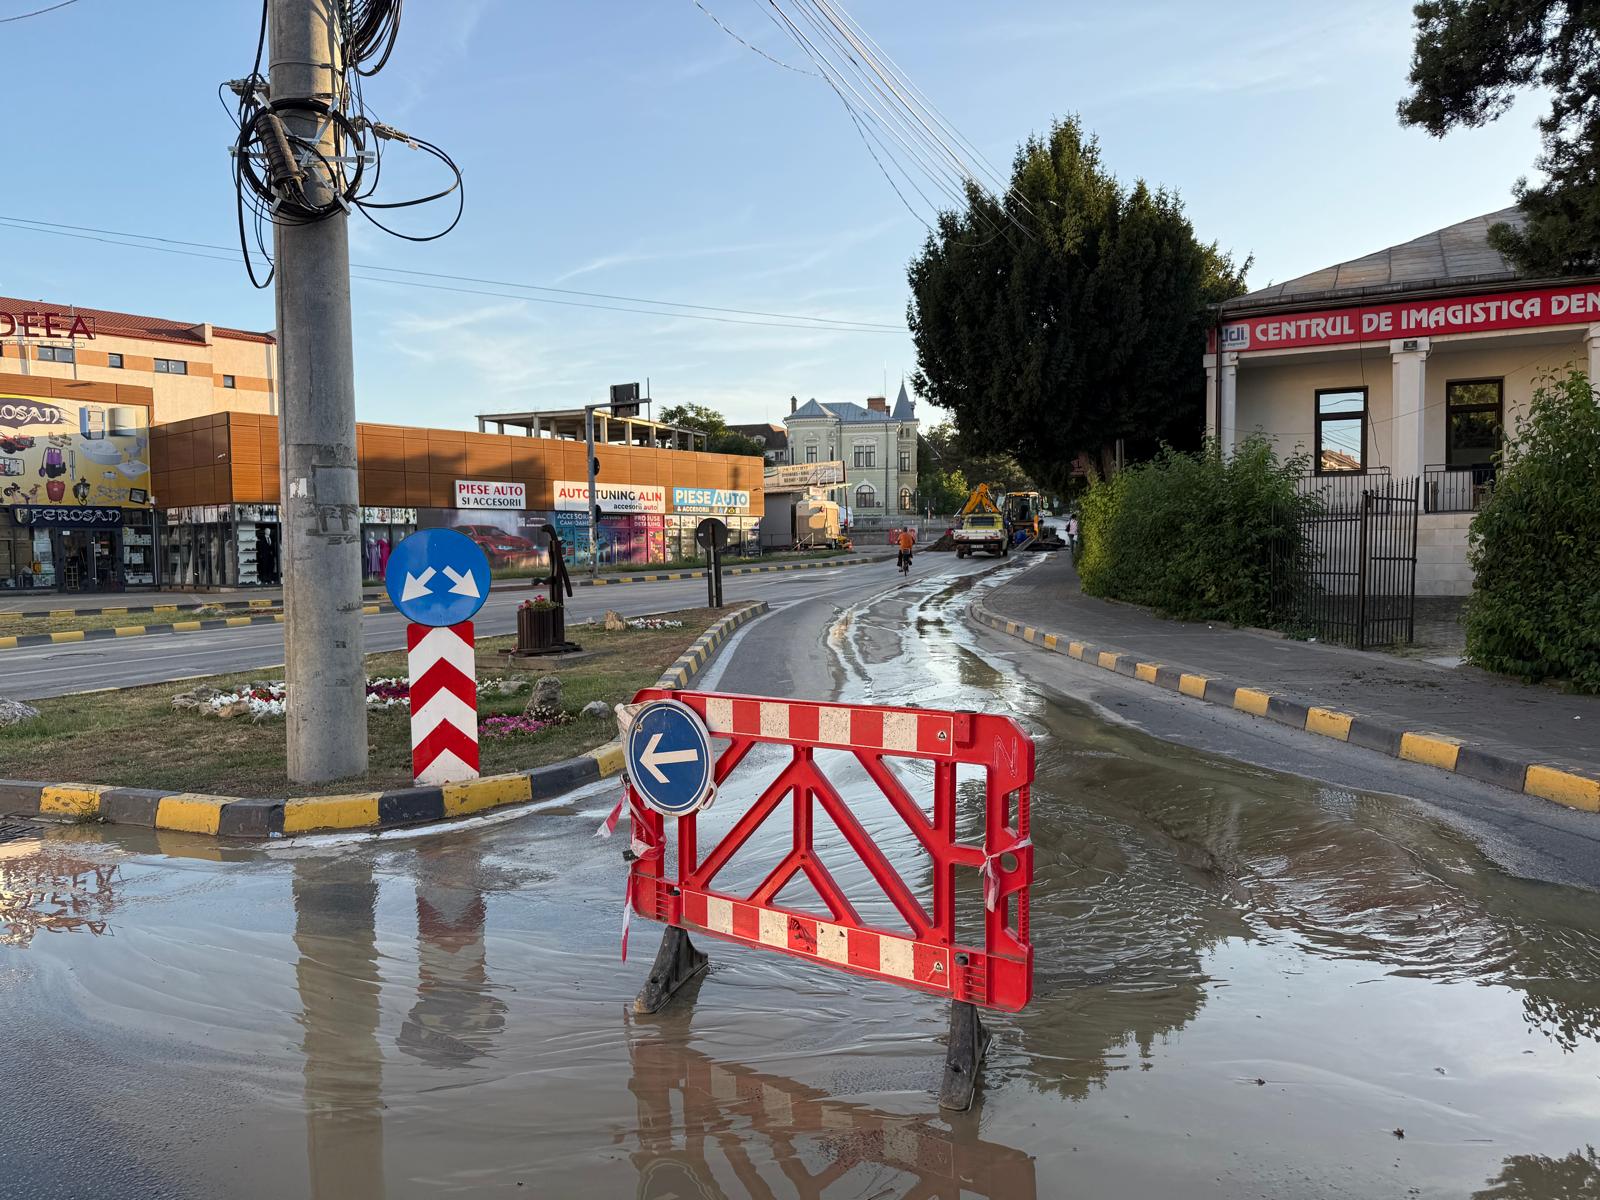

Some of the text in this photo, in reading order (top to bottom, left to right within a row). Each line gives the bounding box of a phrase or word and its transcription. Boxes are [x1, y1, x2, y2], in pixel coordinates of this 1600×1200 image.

[1255, 314, 1355, 341] CENTRUL
[1362, 312, 1392, 333] DE
[1401, 297, 1541, 330] IMAGISTICA
[0, 405, 60, 424] OSAN
[458, 483, 523, 496] PIESE AUTO
[595, 489, 636, 501] TUNING
[638, 491, 662, 502] ALIN
[461, 497, 521, 507] SI ACCESORII
[675, 489, 748, 506] PIESE AUTO
[643, 503, 658, 511] auto
